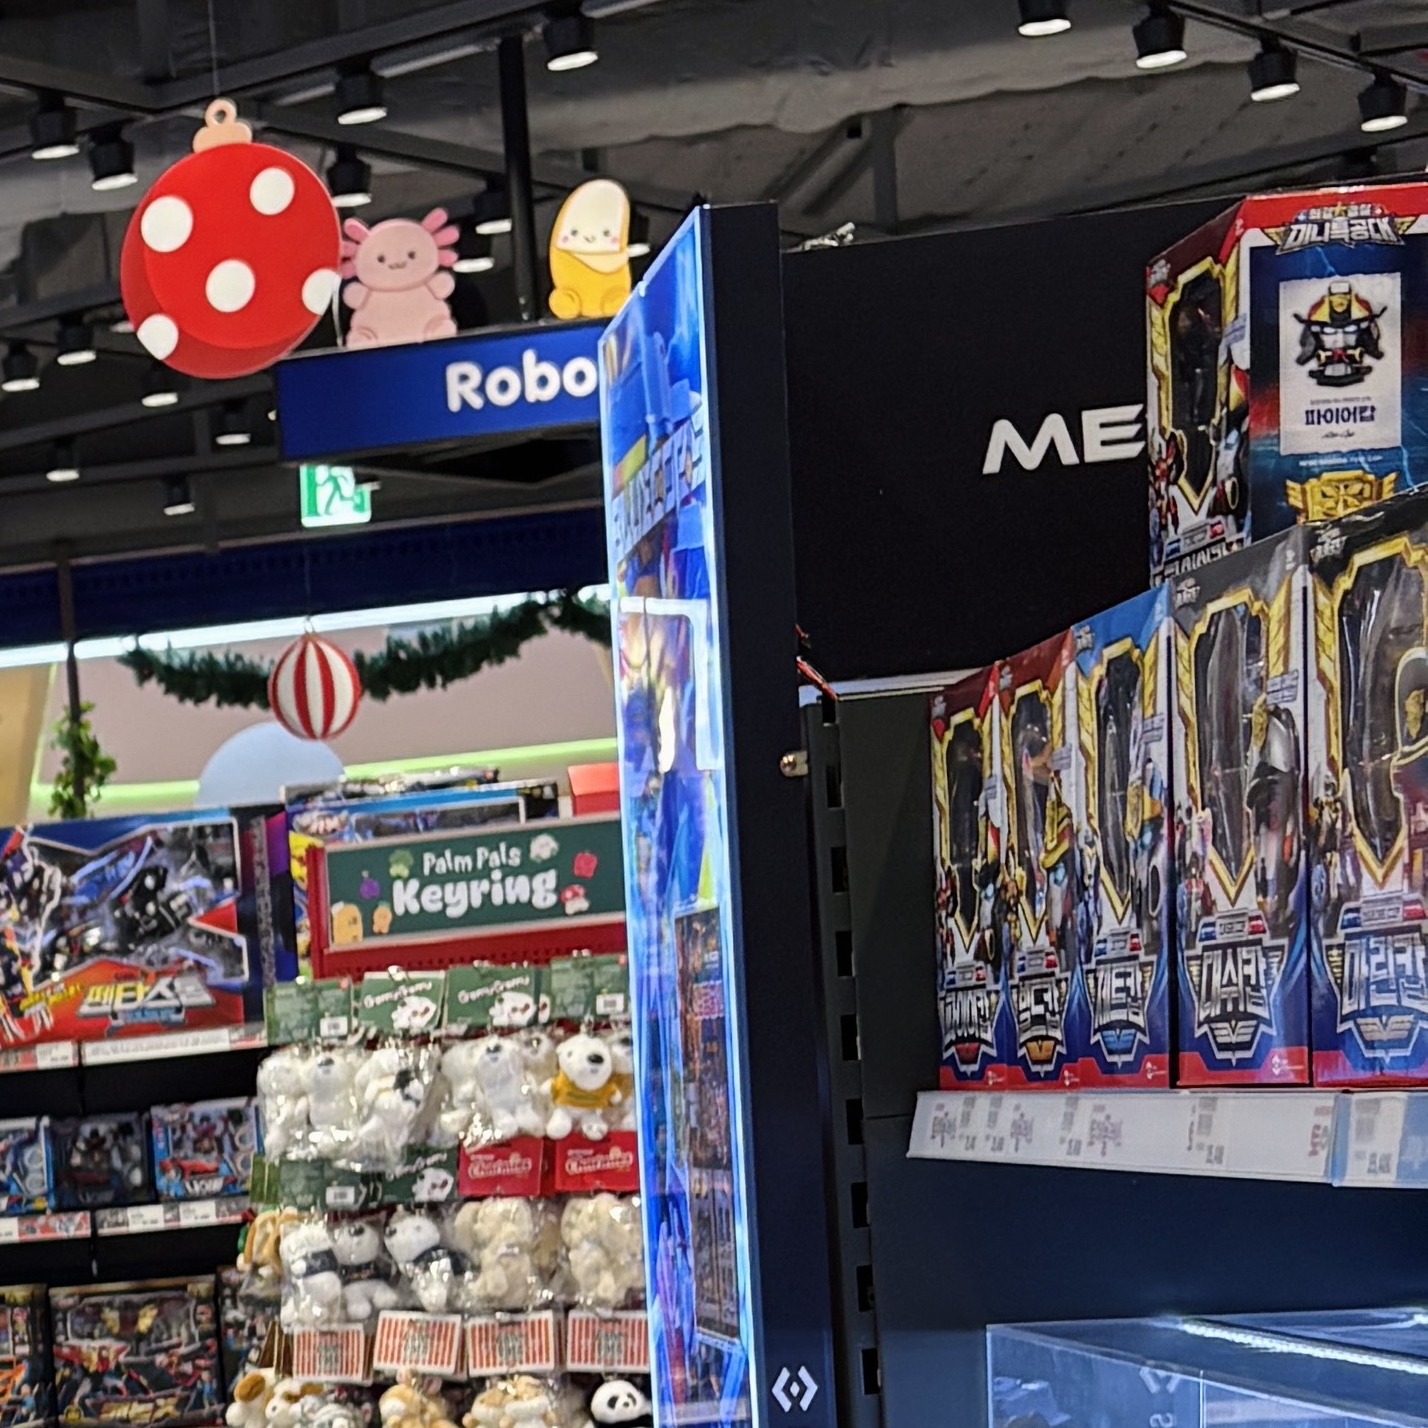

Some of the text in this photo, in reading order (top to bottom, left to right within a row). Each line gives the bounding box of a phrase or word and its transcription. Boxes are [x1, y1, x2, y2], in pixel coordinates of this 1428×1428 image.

[1288, 220, 1398, 250] 미니특공대
[1303, 407, 1377, 428] 파이어캅
[421, 842, 522, 878] Palm Pals
[391, 868, 559, 919] Keyring
